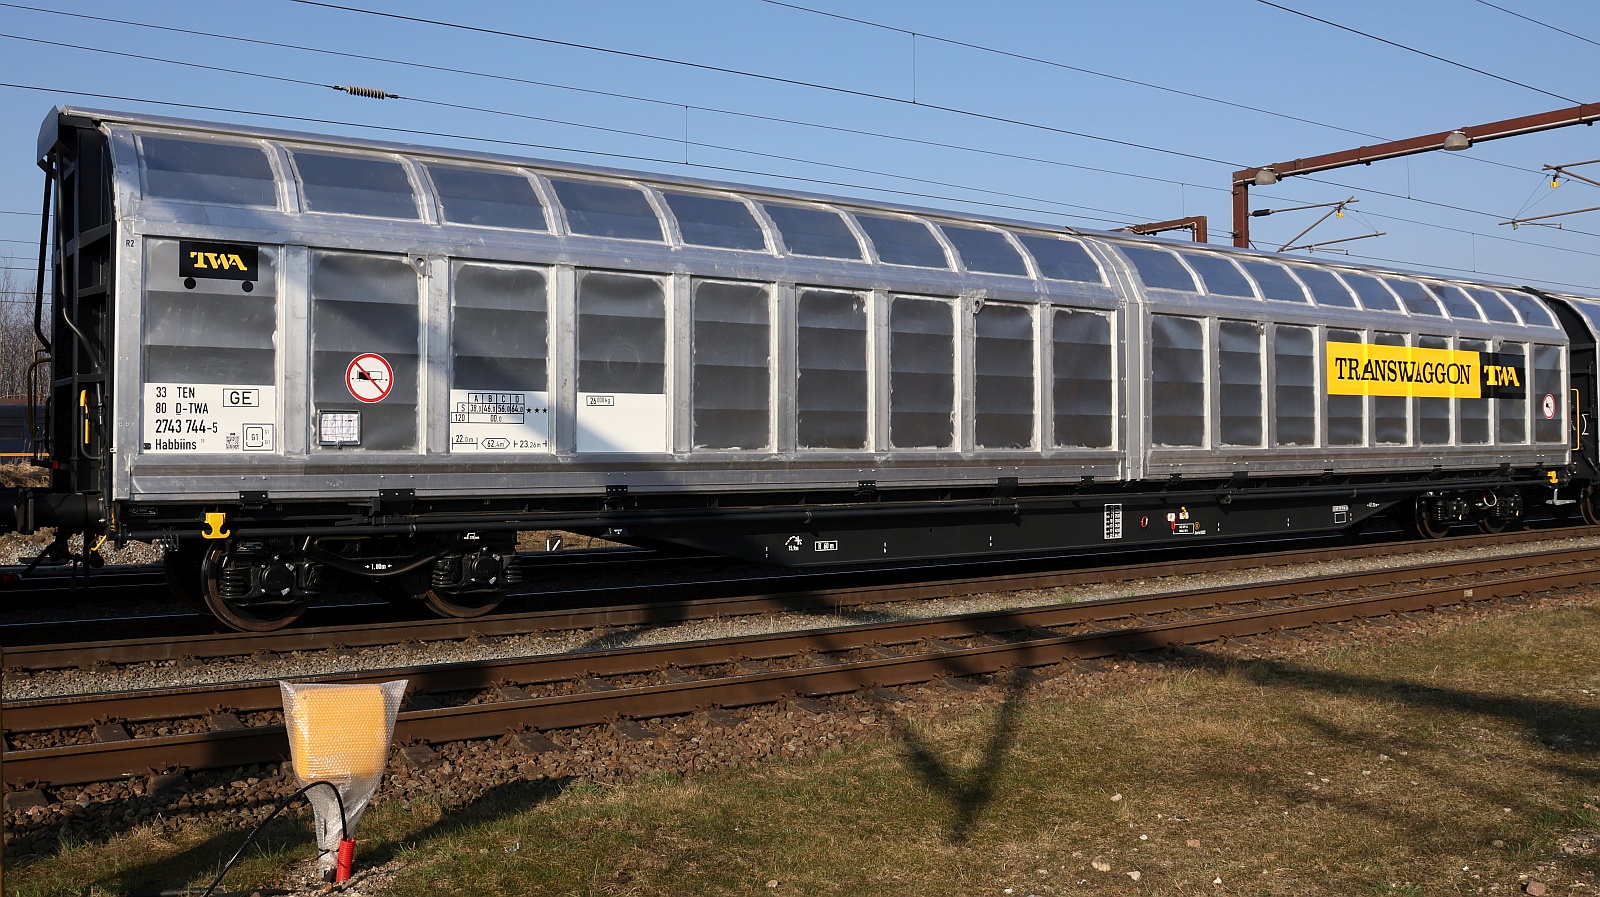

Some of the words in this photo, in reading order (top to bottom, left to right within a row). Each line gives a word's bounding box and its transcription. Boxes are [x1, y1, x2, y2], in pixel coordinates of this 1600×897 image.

[190, 251, 248, 271] TWA
[1335, 357, 1471, 385] TRANSWAGGON
[1484, 365, 1520, 387] TWA
[156, 386, 167, 398] 33
[177, 387, 195, 398] TEN
[230, 391, 252, 405] GE
[155, 402, 167, 413] 80
[176, 402, 209, 415] D-TWA
[461, 404, 466, 412] S
[455, 413, 465, 422] 120
[155, 419, 182, 433] 2743
[186, 419, 218, 433] 744-5
[155, 439, 197, 450] Habbiins
